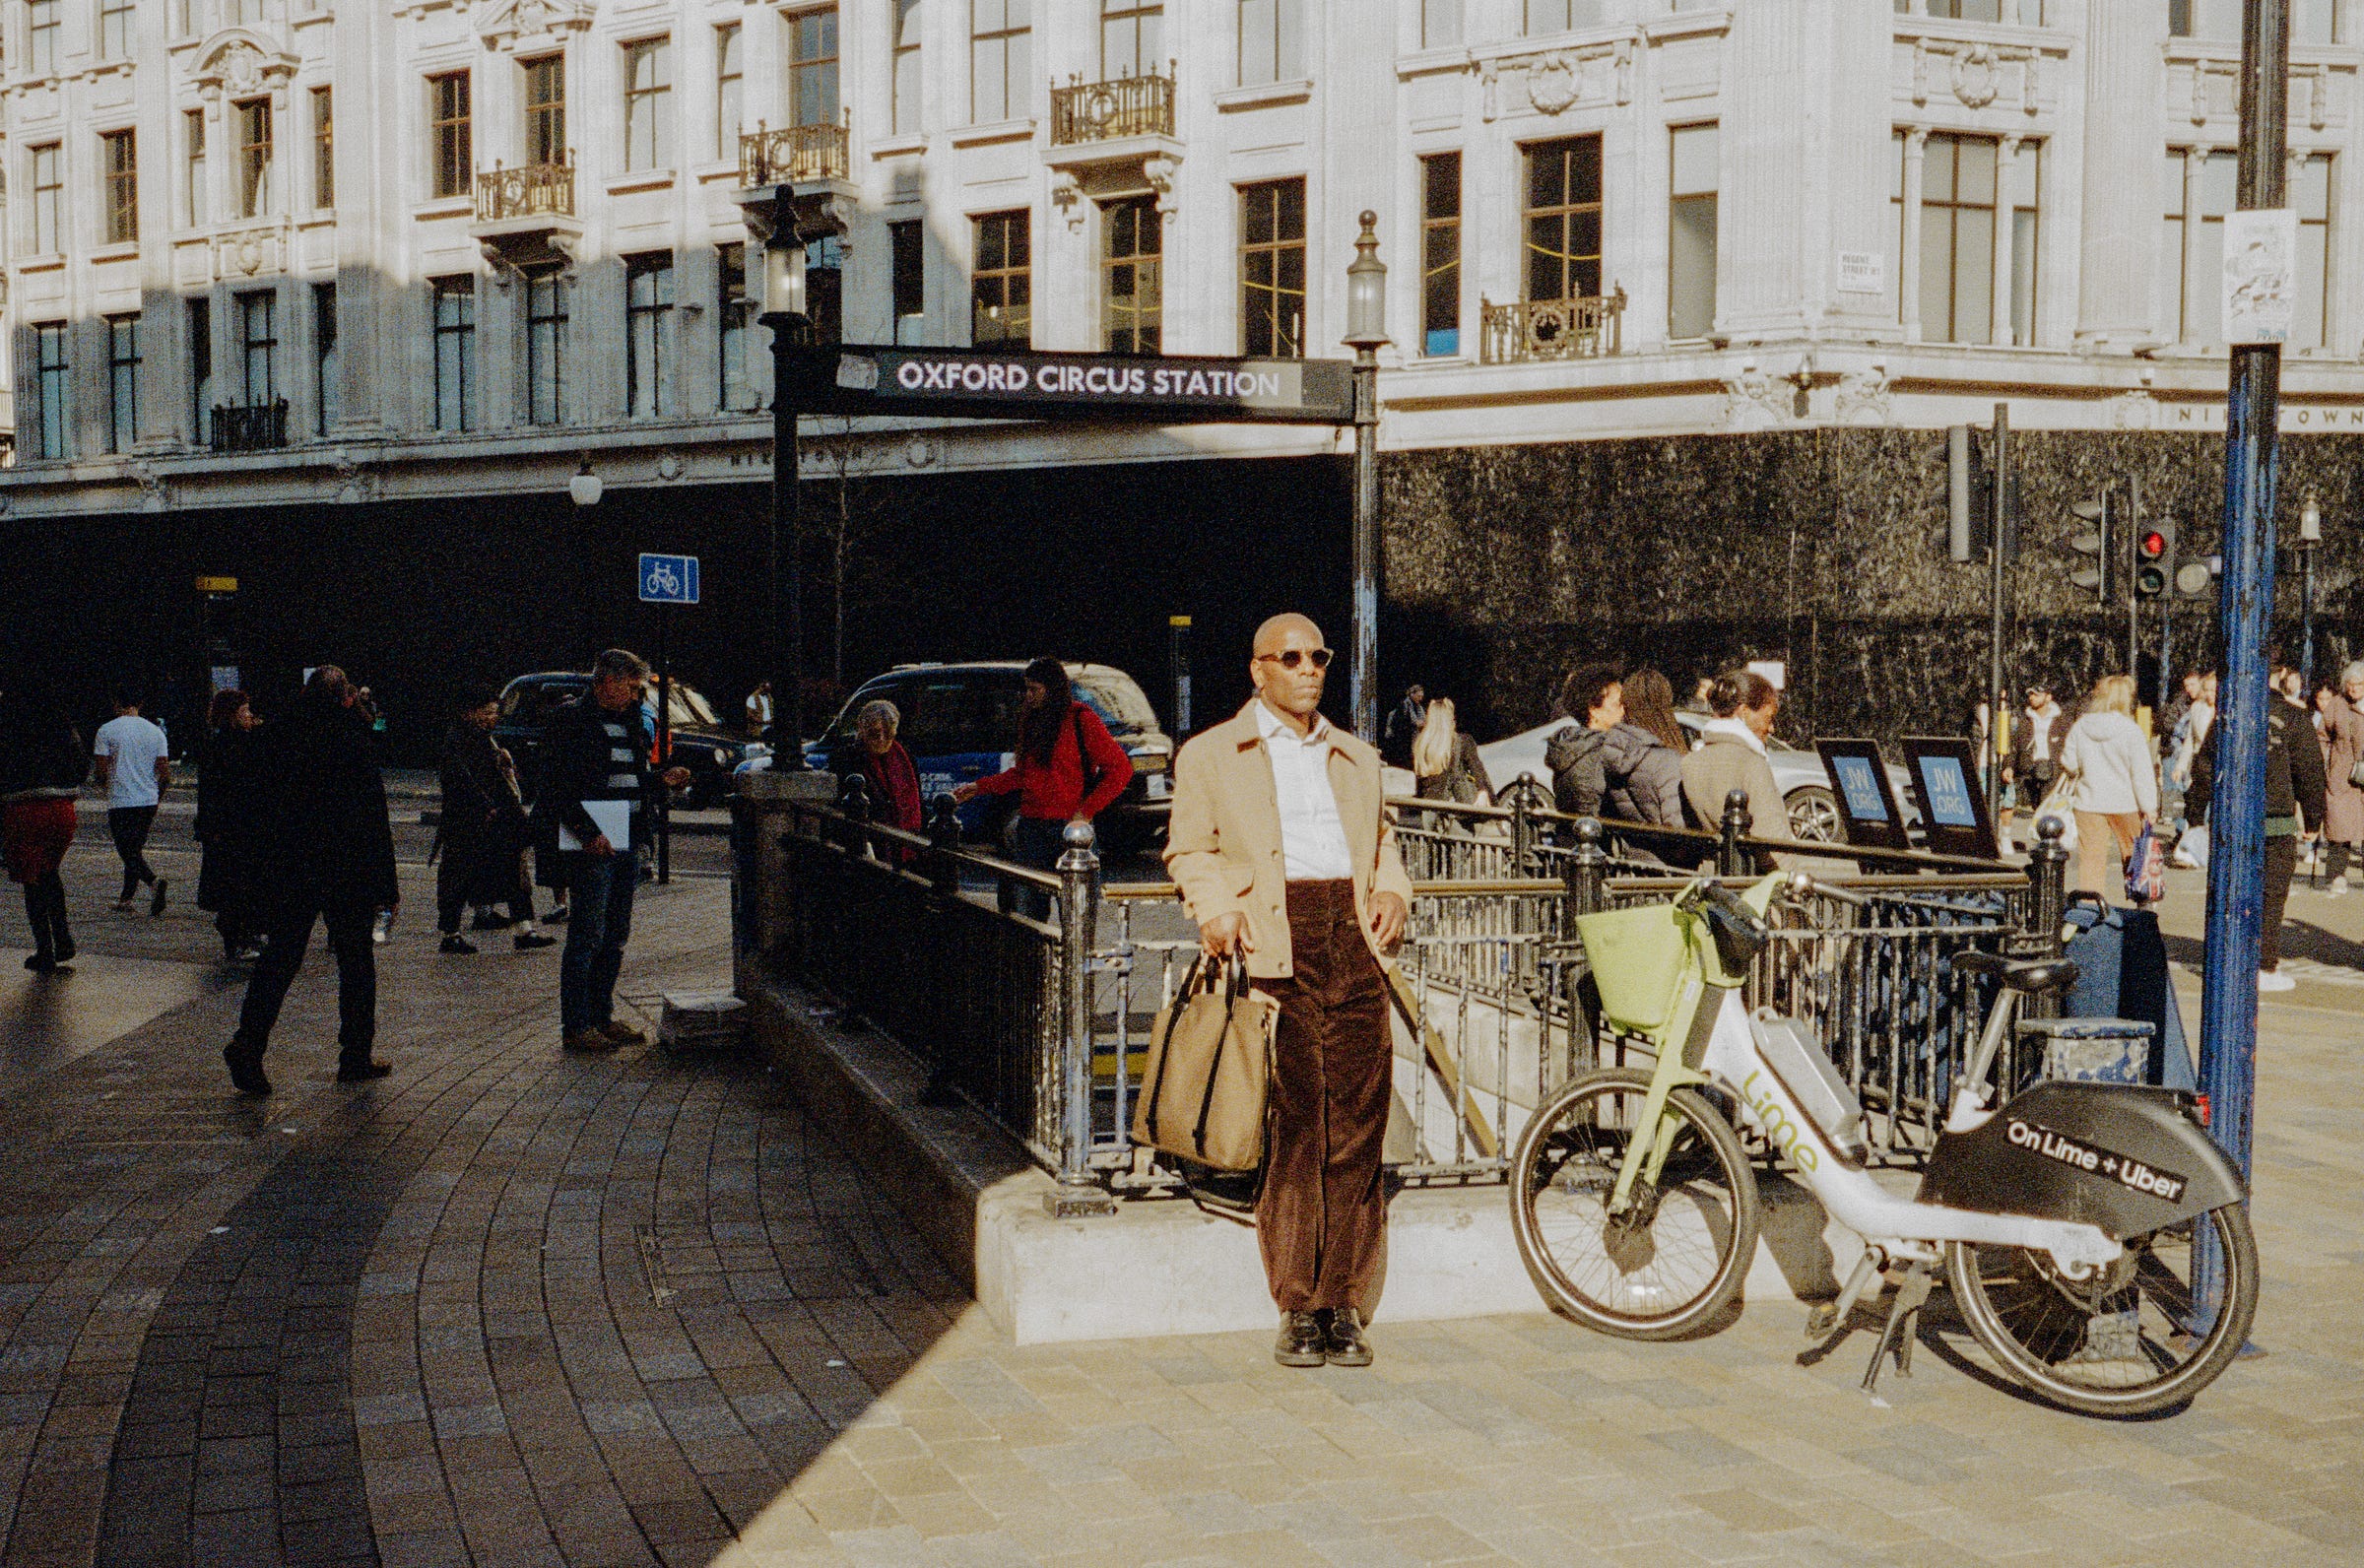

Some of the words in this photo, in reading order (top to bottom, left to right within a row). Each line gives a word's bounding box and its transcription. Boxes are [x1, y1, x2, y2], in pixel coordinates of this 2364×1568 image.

[898, 361, 1029, 390] OXFORD
[1037, 365, 1145, 393] CIRCUS
[1152, 368, 1280, 396] STATION
[1846, 766, 1870, 790] JW
[1934, 767, 1956, 793] JW
[1742, 1069, 1818, 1178] Lime
[2007, 1121, 2042, 1150] On
[2042, 1133, 2099, 1170] Lime
[2102, 1157, 2118, 1173] +
[2120, 1159, 2183, 1199] Uber
